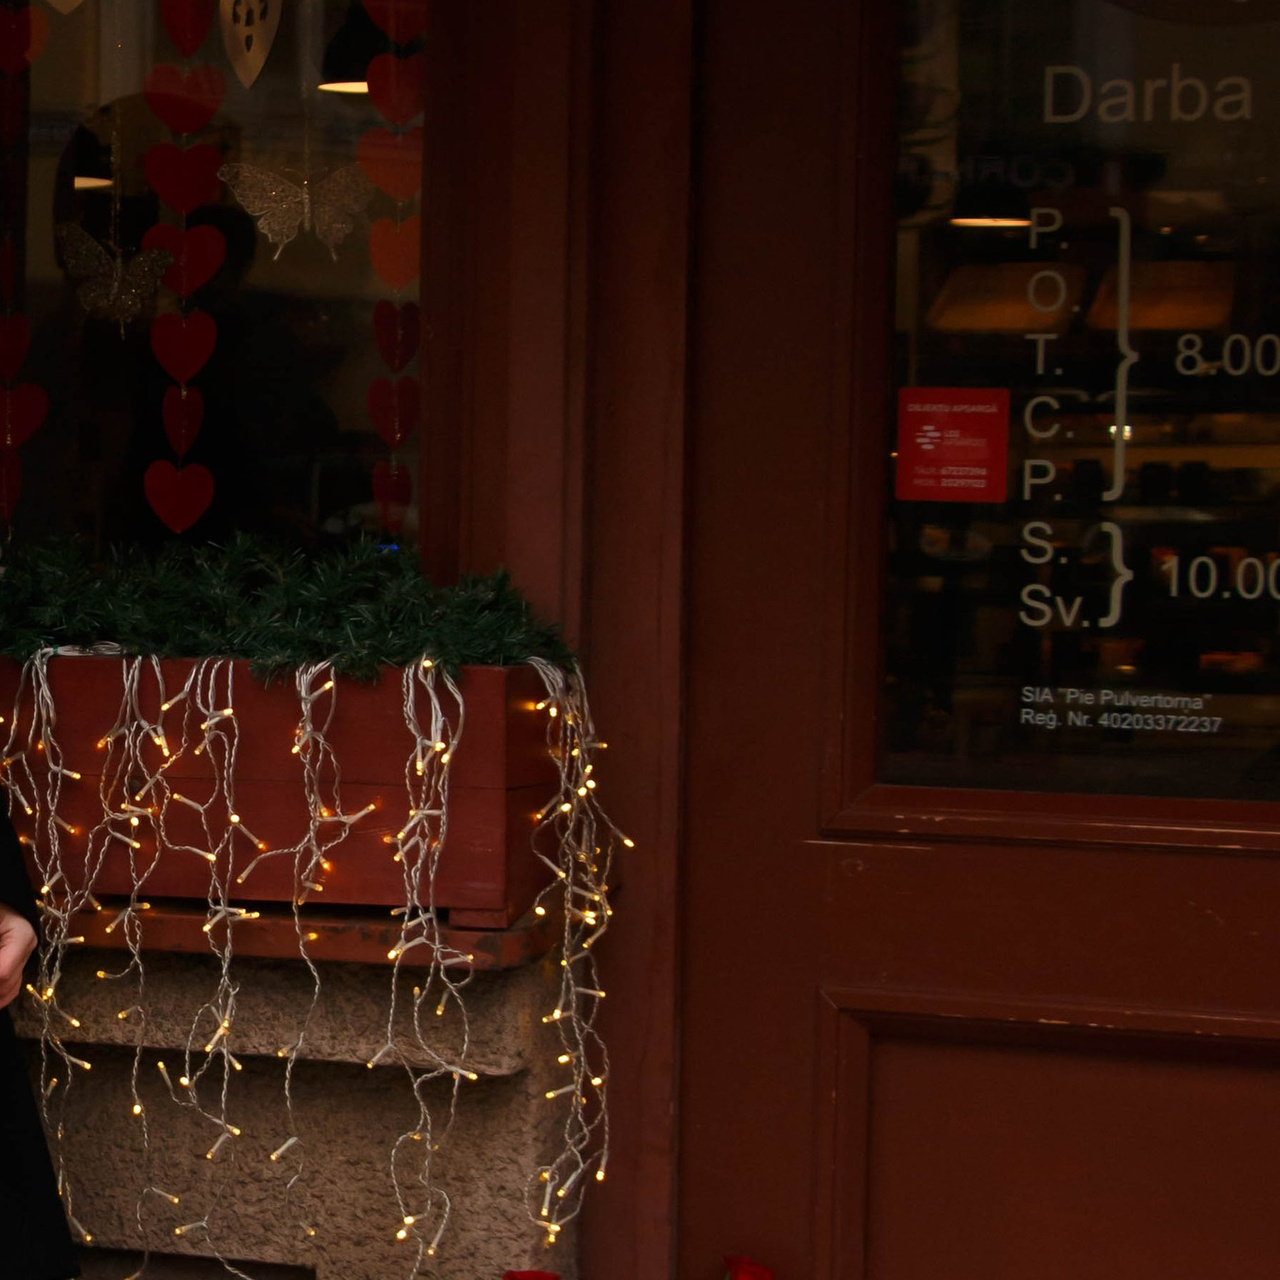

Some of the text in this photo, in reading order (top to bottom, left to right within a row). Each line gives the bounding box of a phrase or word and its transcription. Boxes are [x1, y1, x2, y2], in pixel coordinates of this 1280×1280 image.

[1044, 64, 1252, 124] Darba
[1175, 333, 1280, 376] 8.00
[1019, 584, 1090, 627] Sv.
[1021, 686, 1054, 703] SIA
[1069, 711, 1094, 728] Nr.
